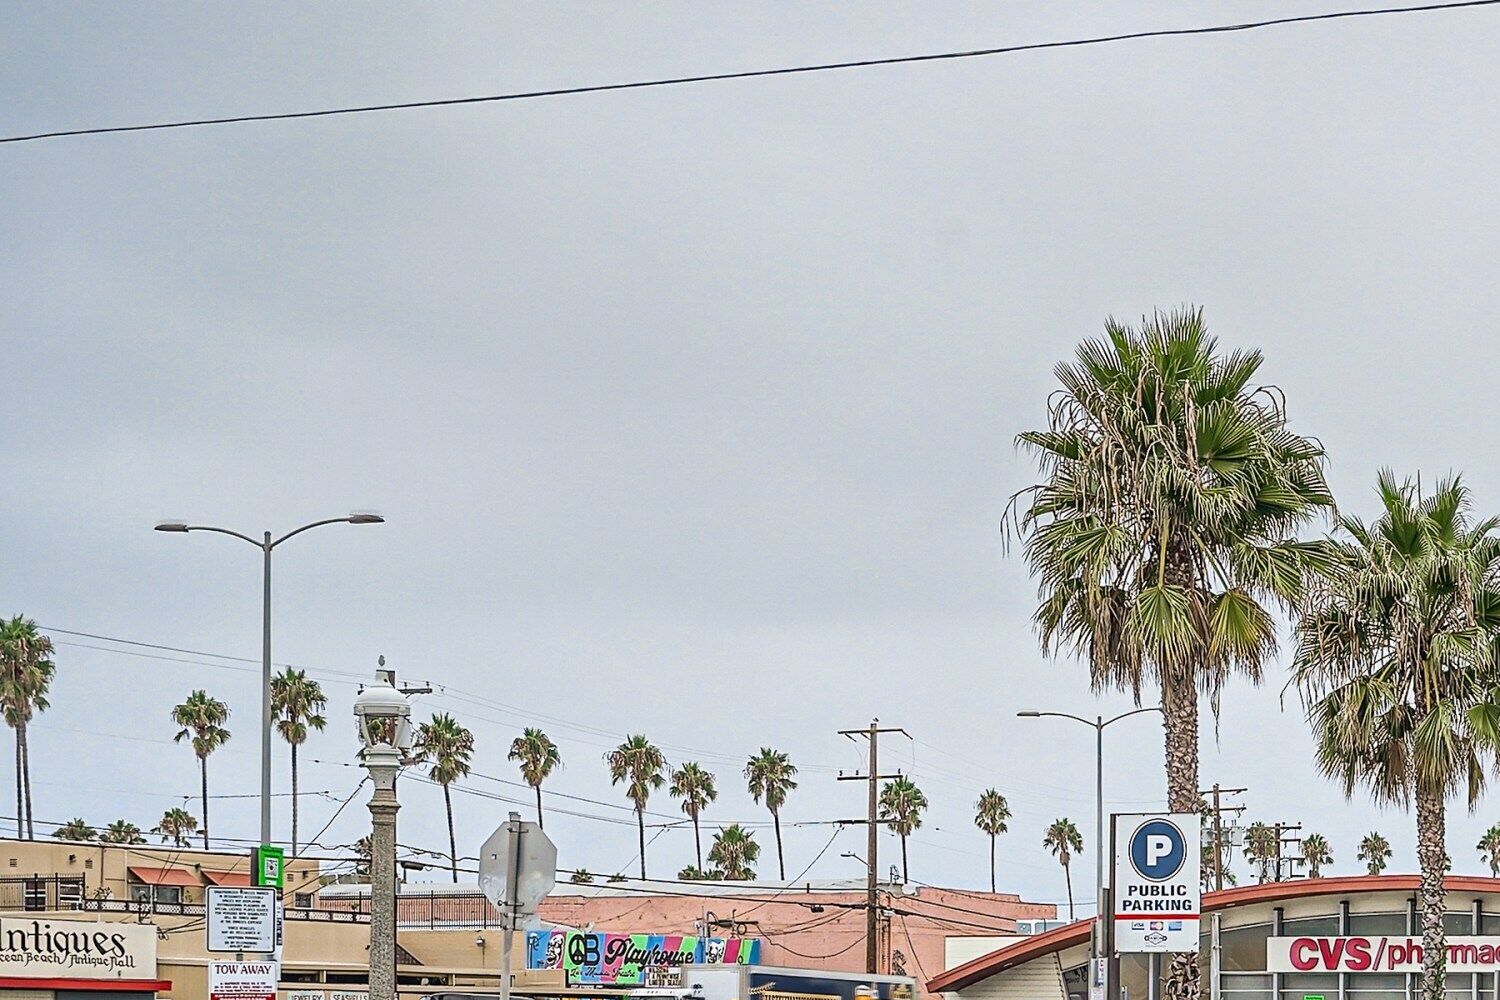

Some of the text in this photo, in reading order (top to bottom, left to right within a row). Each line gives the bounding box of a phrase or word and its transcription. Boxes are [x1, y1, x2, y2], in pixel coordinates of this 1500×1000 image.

[1147, 835, 1173, 866] P
[1128, 885, 1187, 896] PUBLIC
[1122, 899, 1192, 911] PARKING
[0, 921, 126, 964] ntiques
[24, 952, 61, 967] Beach
[68, 954, 110, 968] Antique
[604, 938, 695, 972] Playhouse
[215, 965, 272, 974] TOW AWAY
